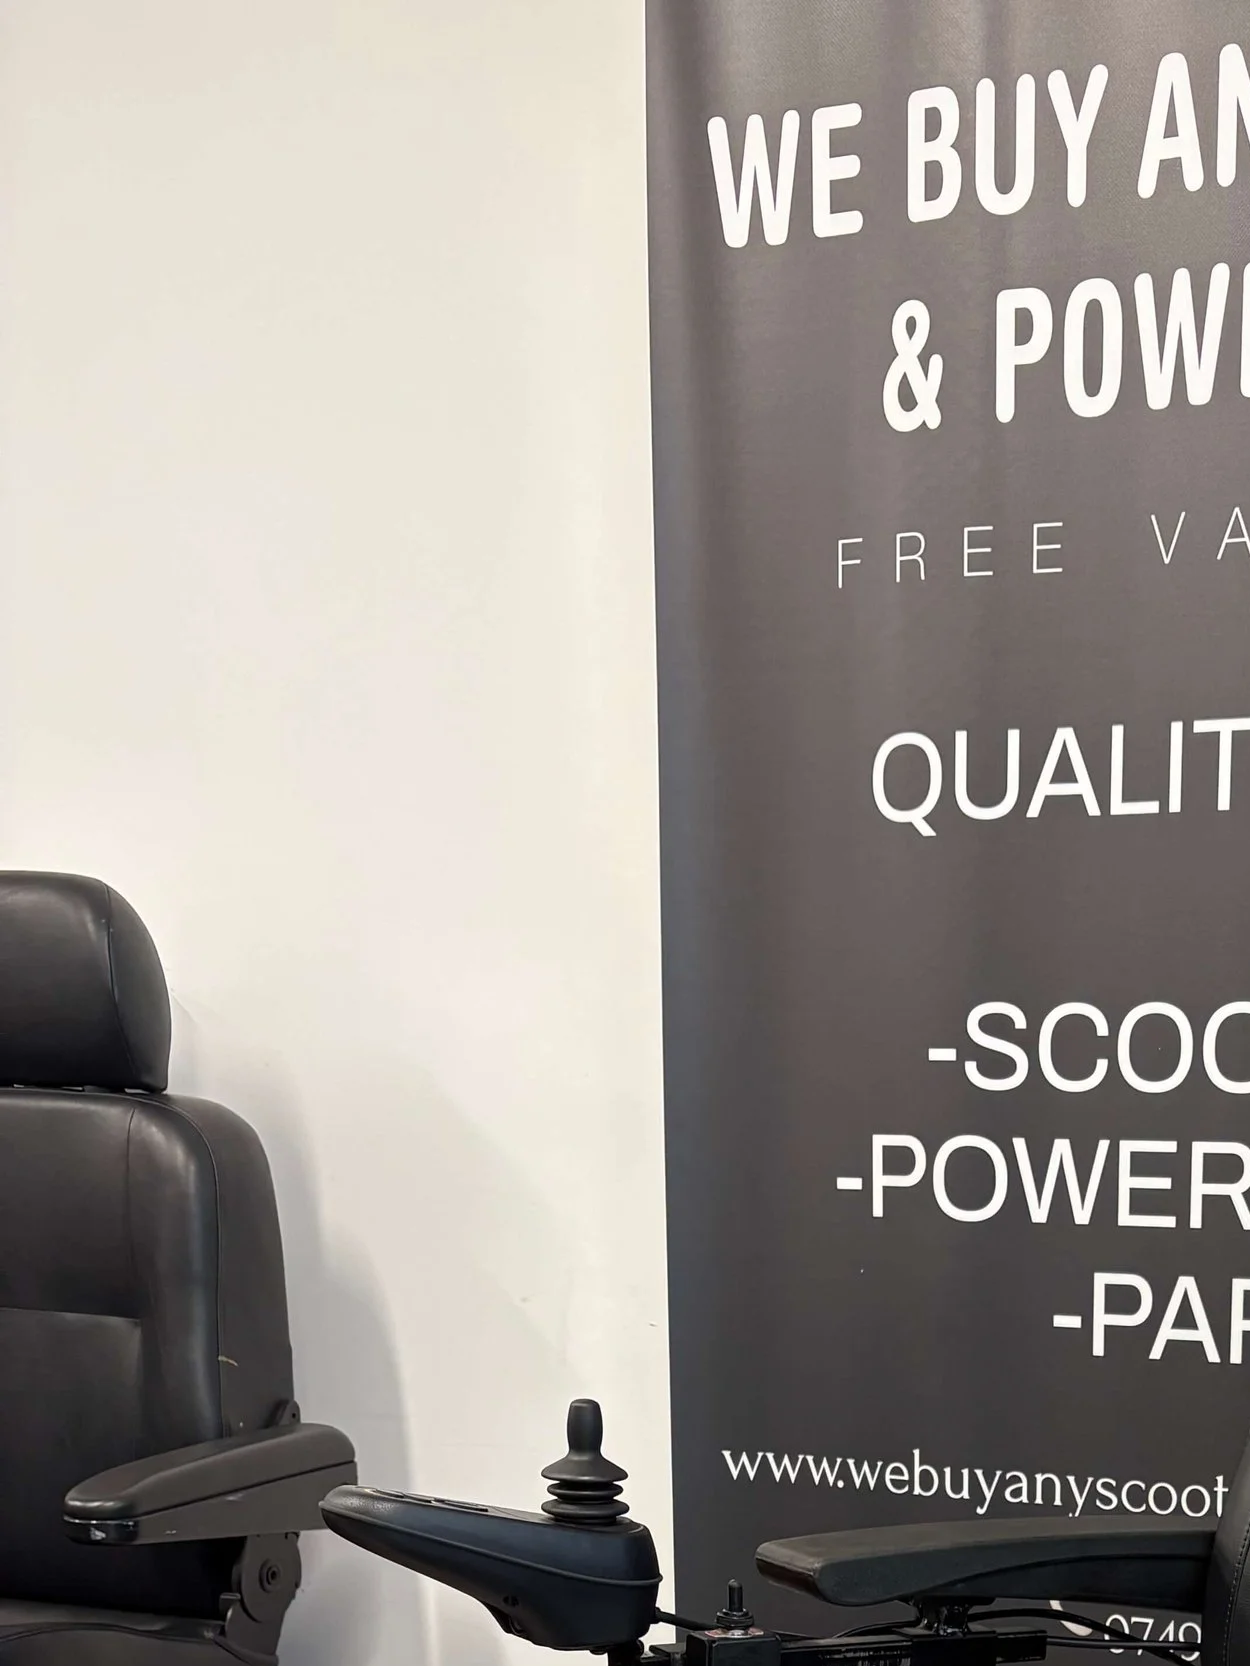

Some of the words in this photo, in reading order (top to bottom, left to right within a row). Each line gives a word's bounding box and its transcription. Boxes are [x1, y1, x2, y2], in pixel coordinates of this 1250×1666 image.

[706, 101, 865, 249] WE
[906, 63, 1110, 223] BUY
[882, 299, 943, 433] &
[838, 522, 1064, 589] FREE
